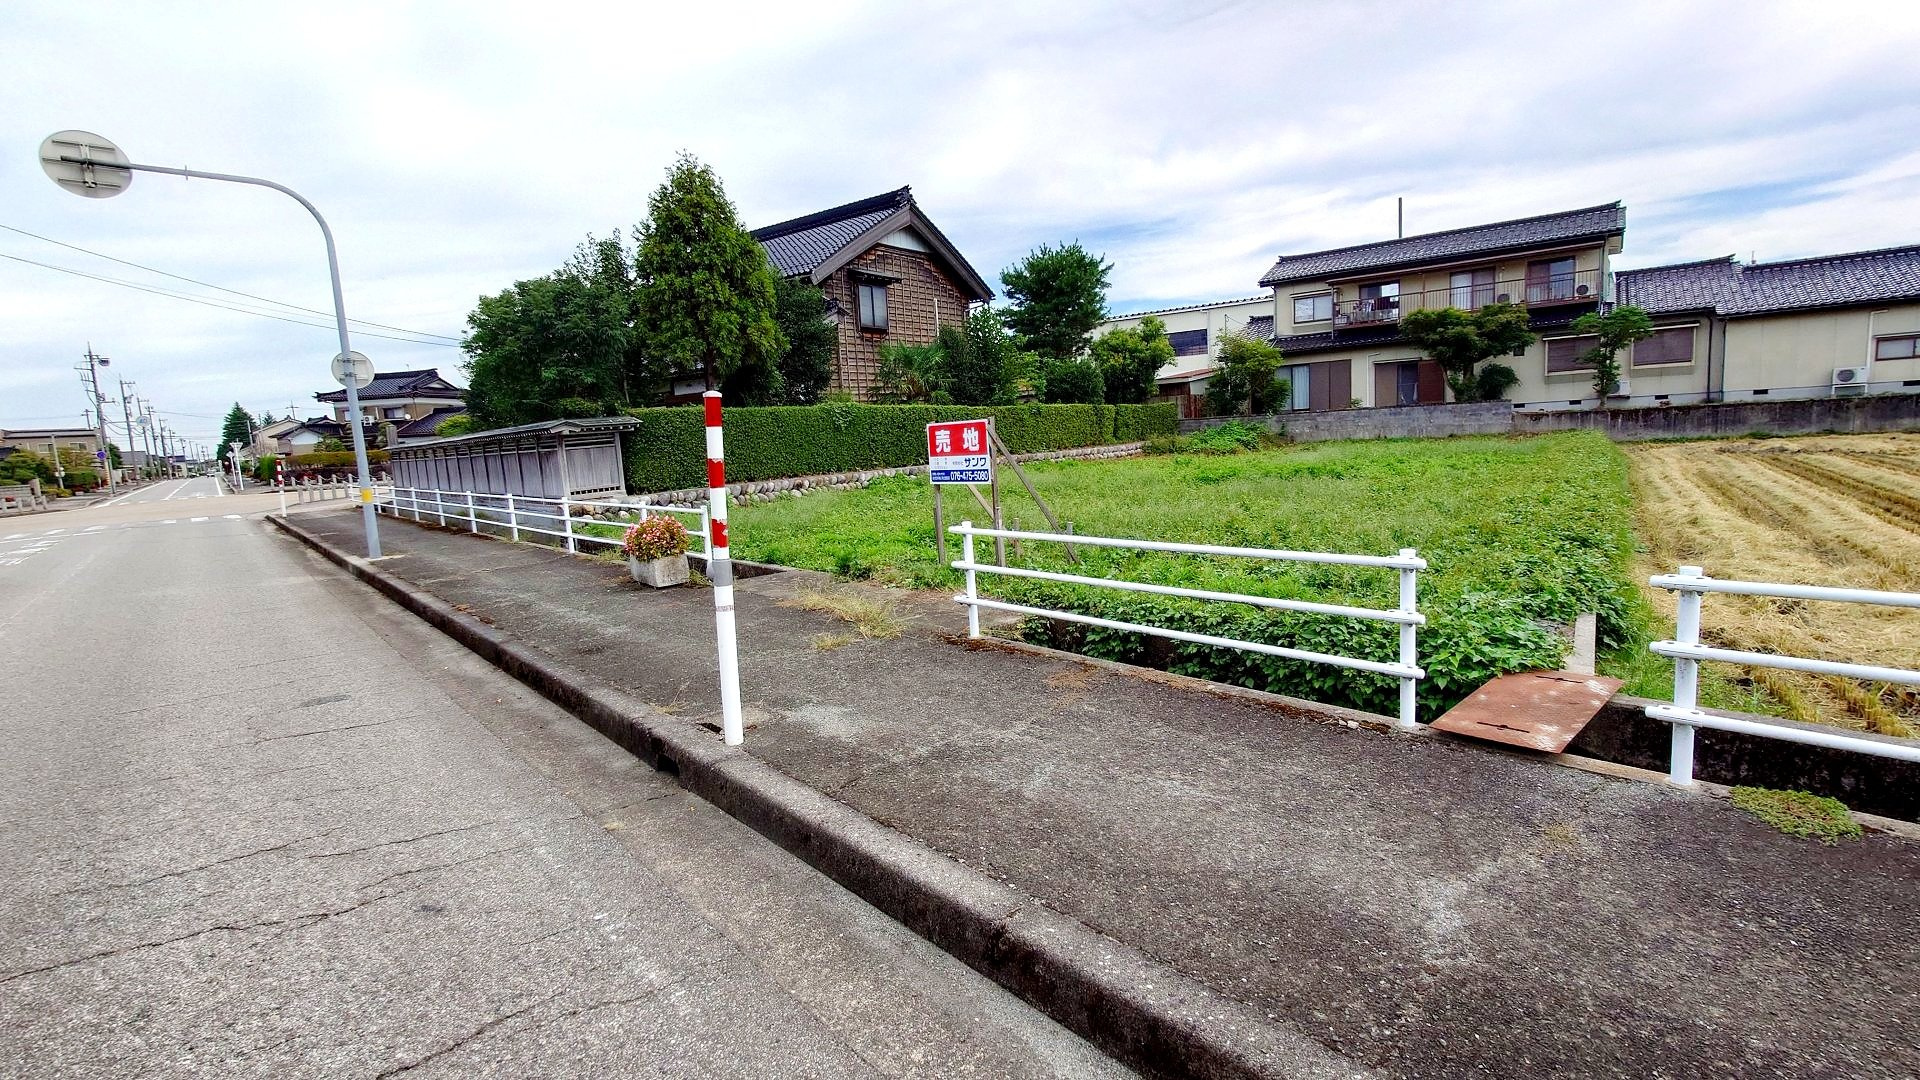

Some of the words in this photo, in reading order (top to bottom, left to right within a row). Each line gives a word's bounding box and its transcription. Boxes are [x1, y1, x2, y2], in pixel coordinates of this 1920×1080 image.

[935, 427, 979, 453] 売地
[964, 457, 987, 467] サンワ
